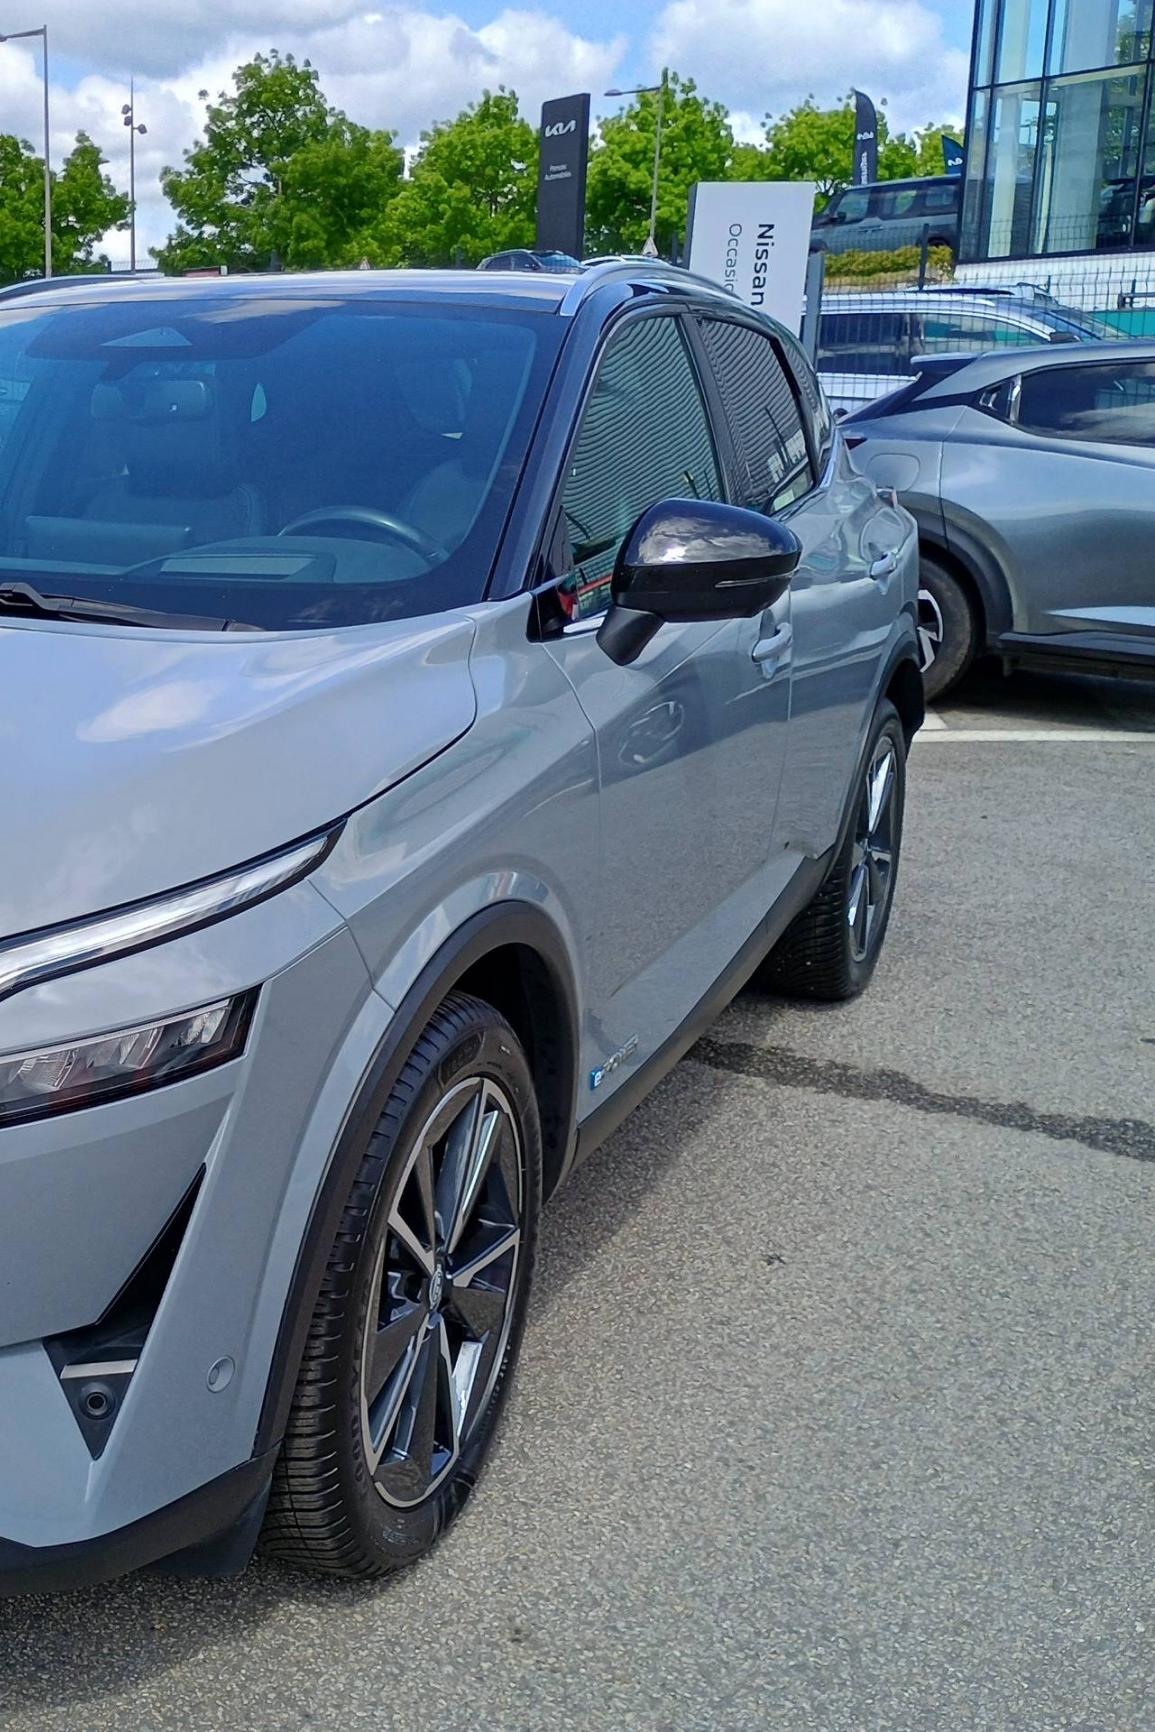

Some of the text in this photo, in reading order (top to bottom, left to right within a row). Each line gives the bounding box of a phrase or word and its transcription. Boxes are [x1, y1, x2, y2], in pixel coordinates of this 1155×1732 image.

[545, 120, 576, 137] KIA
[724, 223, 743, 293] Occasio
[750, 223, 775, 306] Nissan
